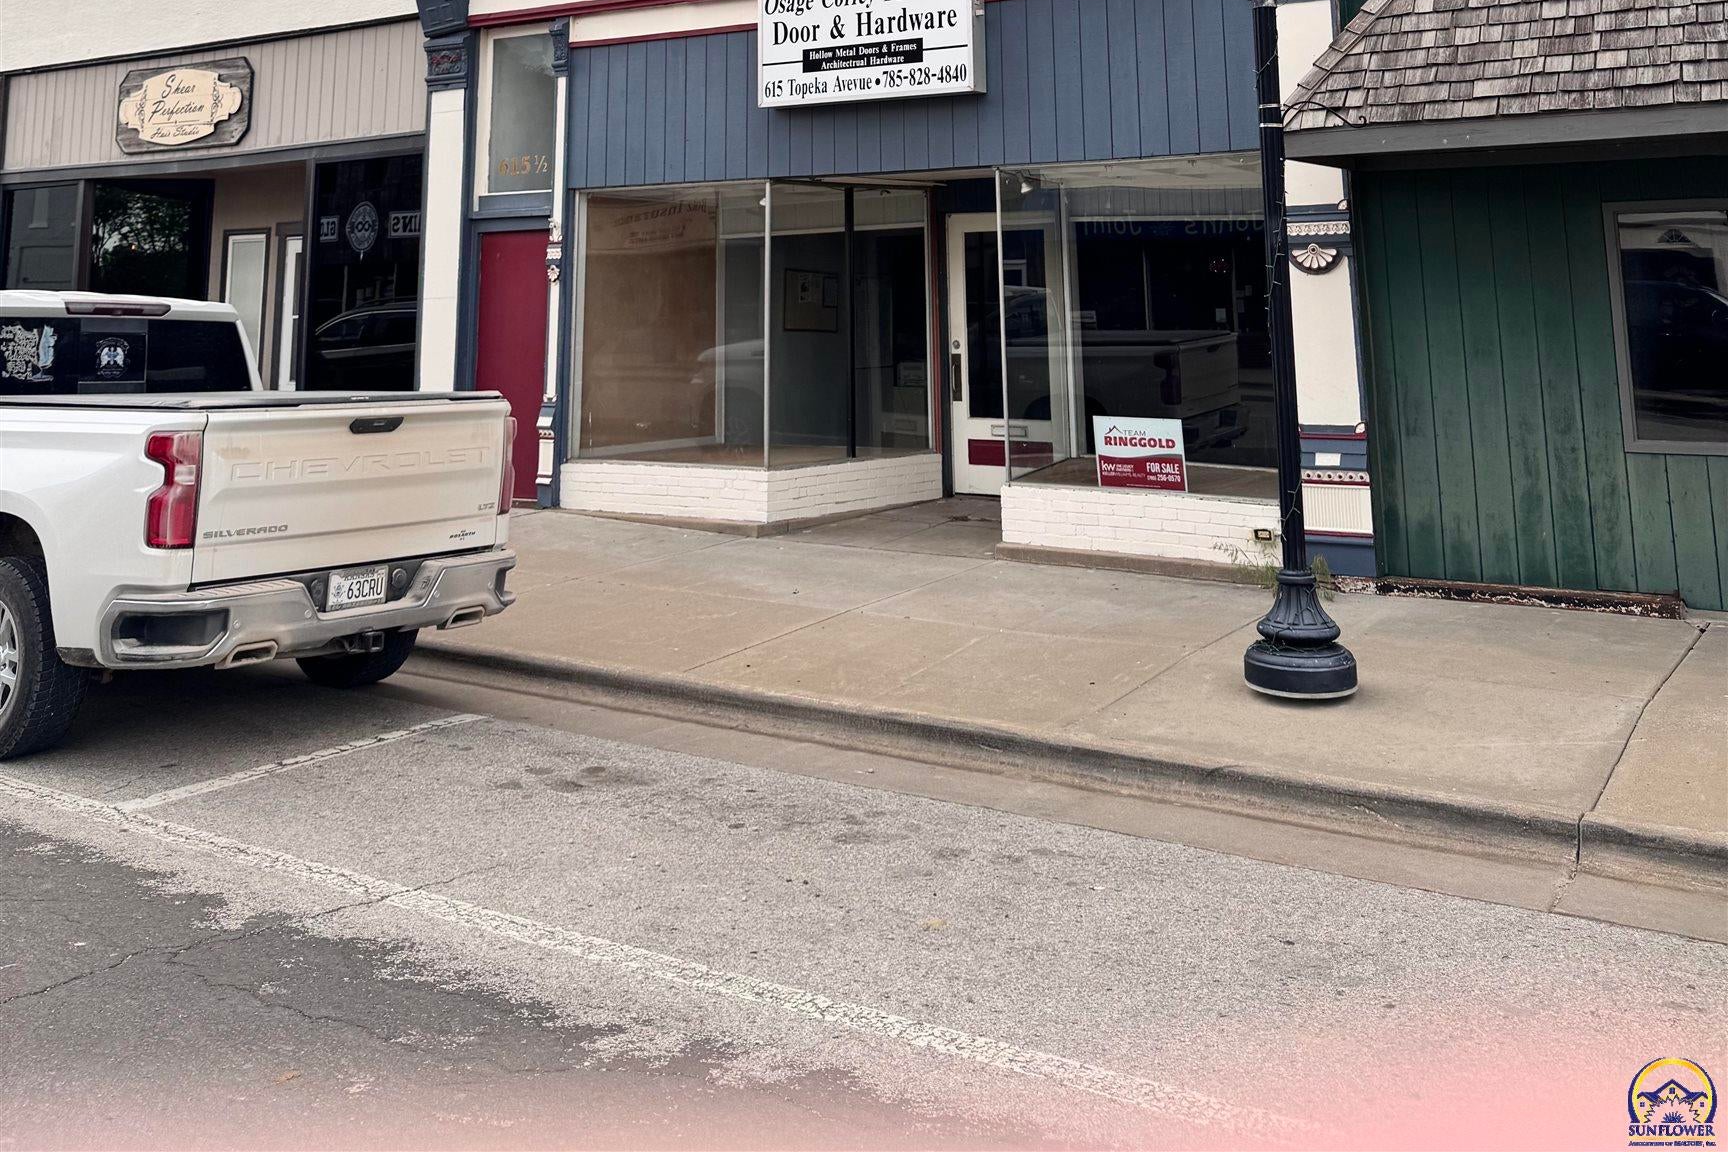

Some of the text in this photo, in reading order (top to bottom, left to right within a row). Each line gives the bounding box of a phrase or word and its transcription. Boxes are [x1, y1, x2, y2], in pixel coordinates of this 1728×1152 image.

[772, 7, 958, 46] Door & Hardware
[809, 42, 917, 60] Hollow Metal Doors & Frames
[869, 55, 905, 65] Hardware
[161, 74, 196, 99] Shear
[764, 79, 784, 98] 615
[787, 77, 828, 99] Topeka
[882, 63, 967, 89] 785-828-4840
[147, 100, 205, 123] Perfection
[172, 127, 200, 137] Studio
[498, 153, 531, 176] 615
[1104, 435, 1176, 449] RINGGOLD
[1123, 429, 1146, 437] TEAM
[230, 446, 490, 481] CHEVROLET
[1146, 462, 1161, 474] FOR
[1161, 463, 1180, 474] SALE
[203, 524, 288, 540] SILVERADO
[347, 577, 384, 600] 63CRU
